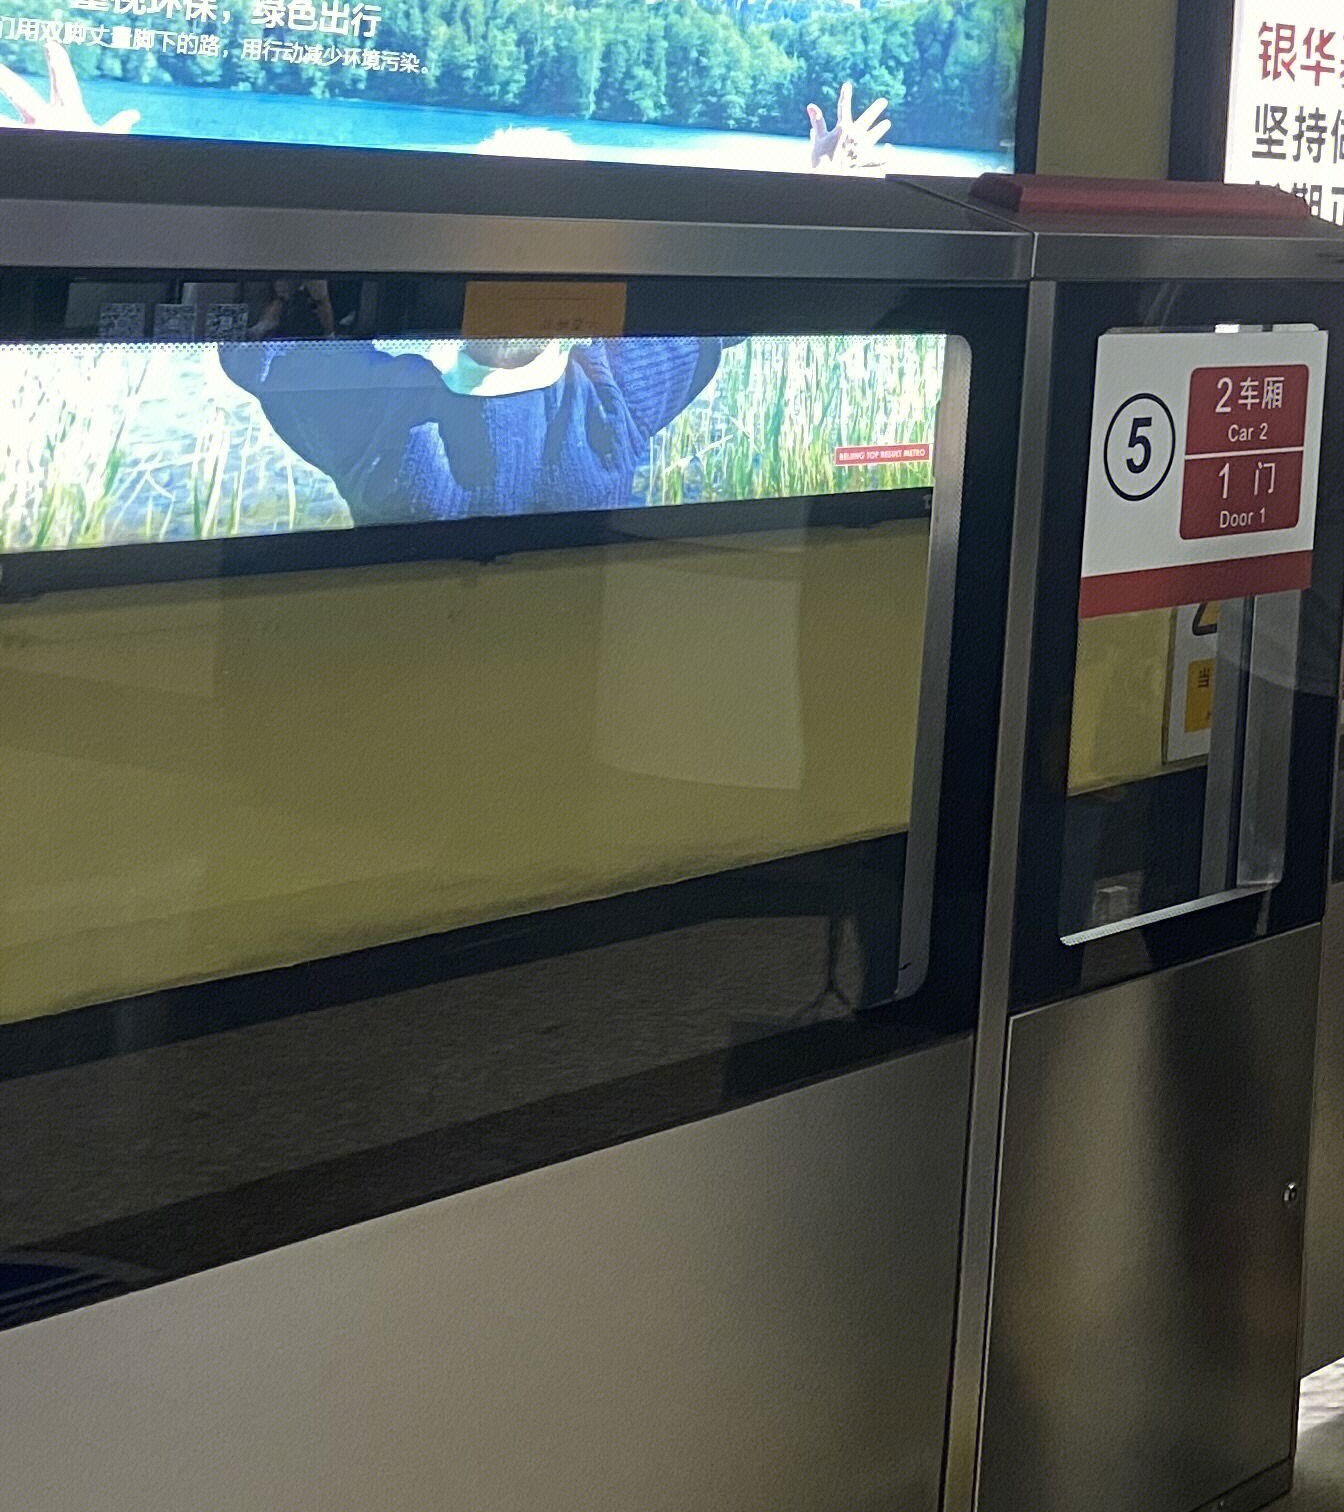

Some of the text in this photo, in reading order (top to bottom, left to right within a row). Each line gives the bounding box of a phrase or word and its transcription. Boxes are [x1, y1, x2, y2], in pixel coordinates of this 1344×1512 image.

[1228, 422, 1268, 443] Car 2
[1126, 416, 1153, 474] 5
[1220, 507, 1266, 529] Door 1
